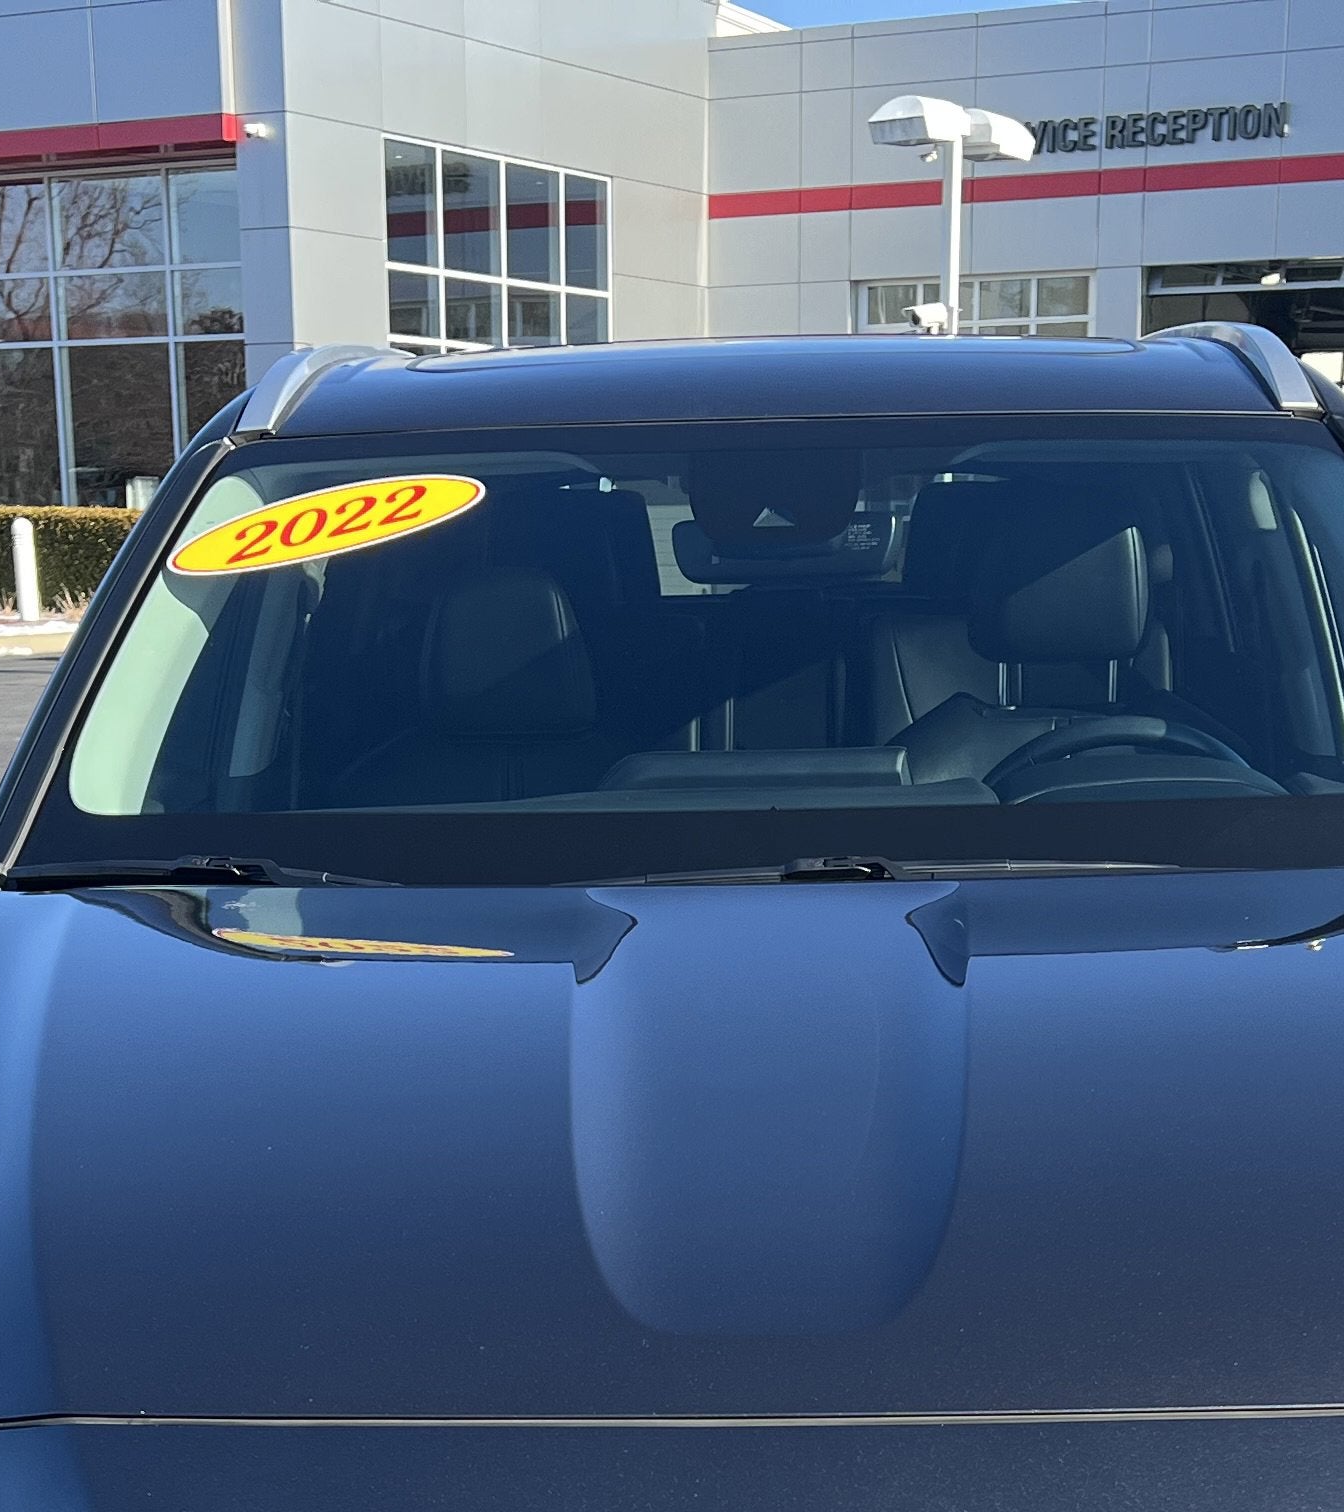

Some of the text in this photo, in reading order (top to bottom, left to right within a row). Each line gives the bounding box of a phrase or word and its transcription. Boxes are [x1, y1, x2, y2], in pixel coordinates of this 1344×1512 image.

[1024, 102, 1288, 155] VICE RECEPTION
[226, 485, 427, 565] 2022
